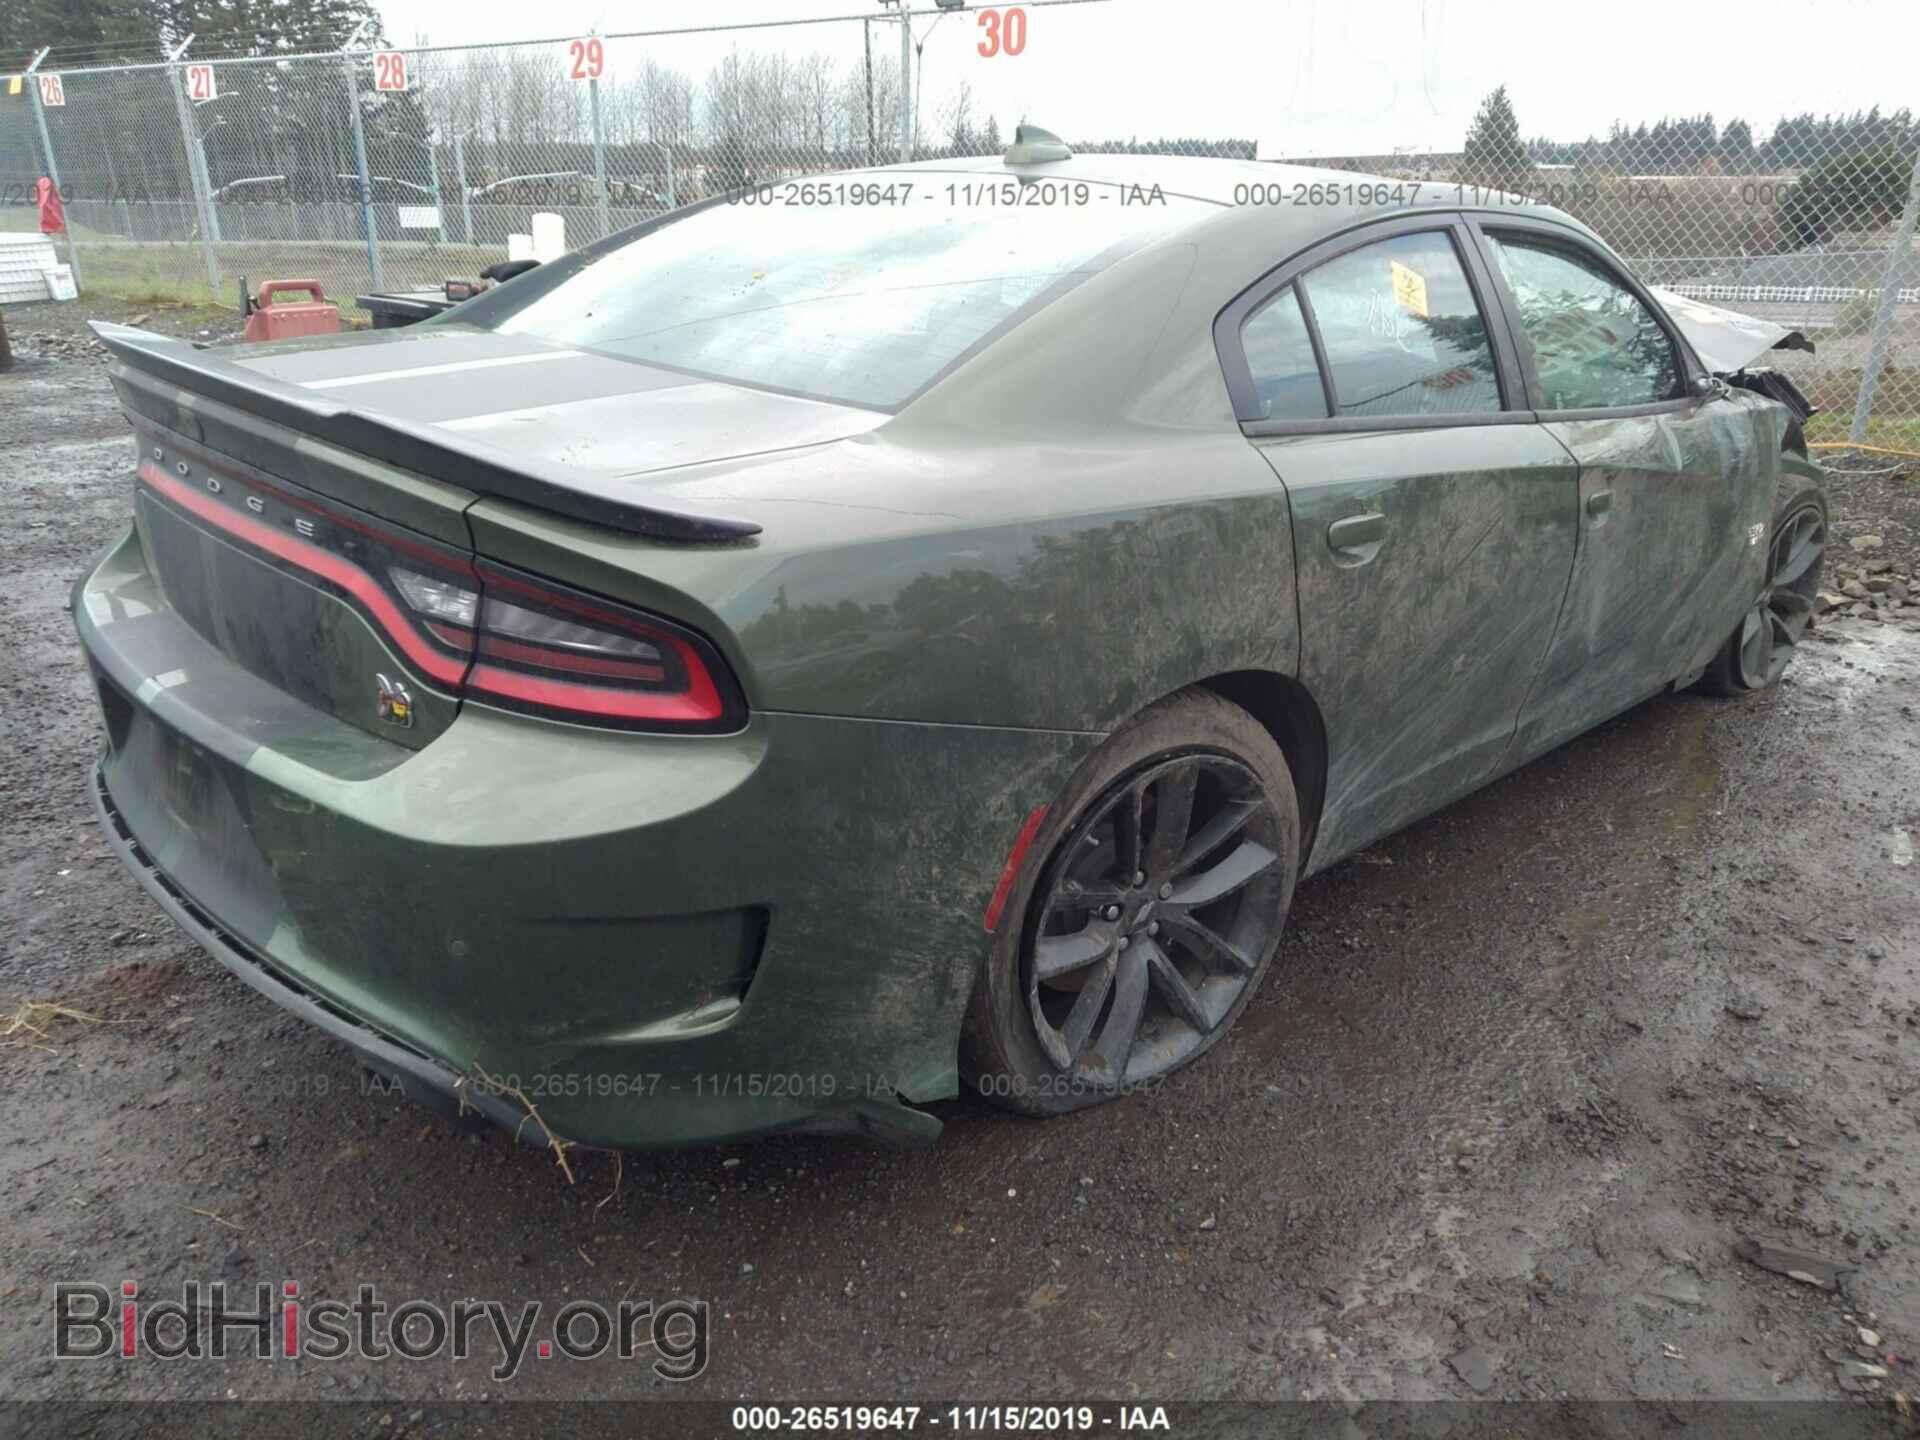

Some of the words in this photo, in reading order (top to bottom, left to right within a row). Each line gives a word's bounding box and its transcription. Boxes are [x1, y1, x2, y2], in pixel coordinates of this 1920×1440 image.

[977, 7, 1026, 58] 30
[376, 53, 406, 90] 28
[570, 38, 604, 80] 29
[43, 77, 62, 104] 26
[191, 67, 210, 98] 27
[154, 447, 314, 537] DODGE
